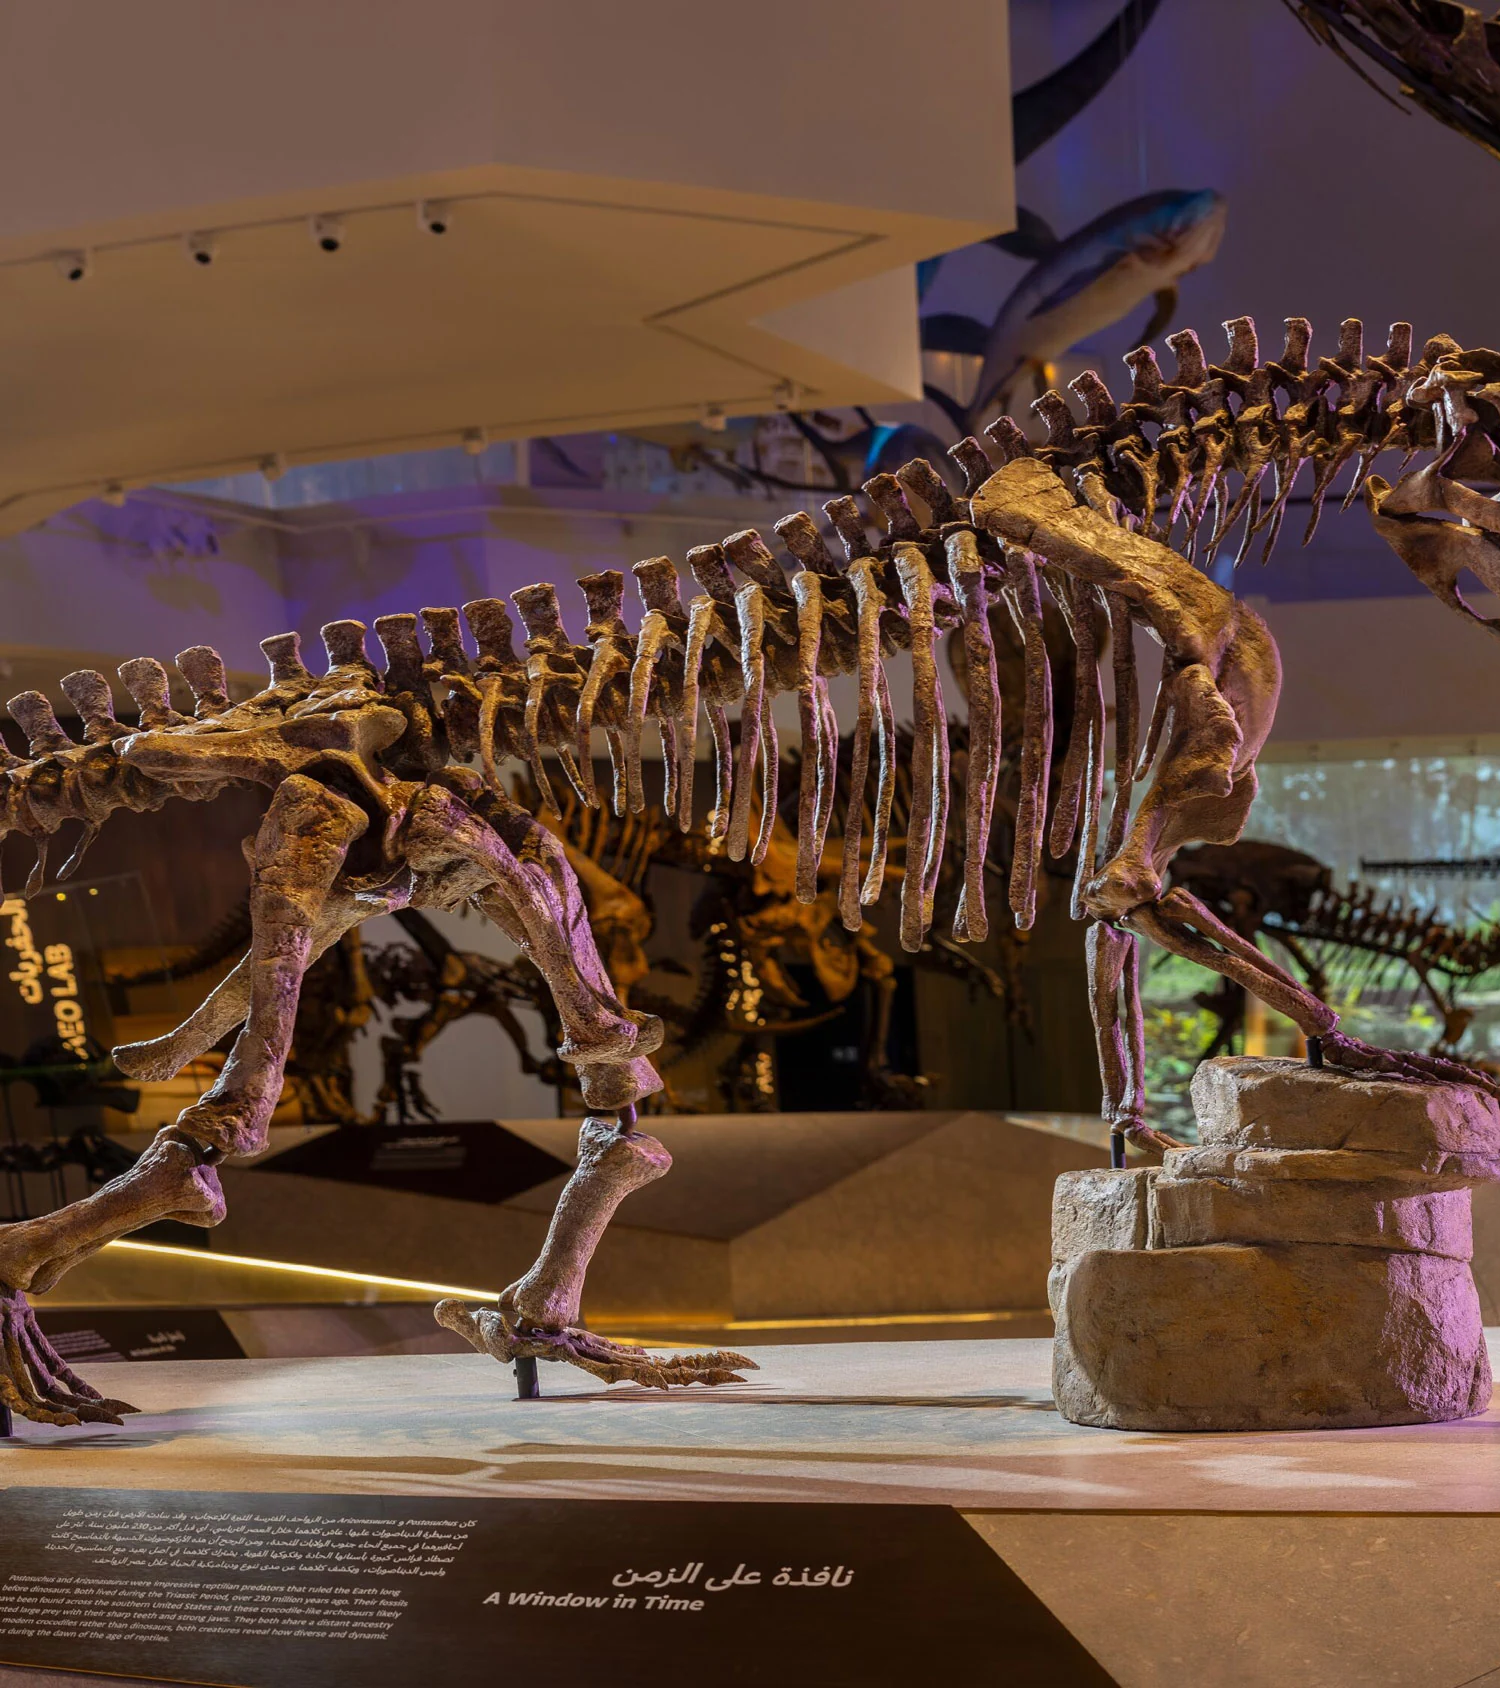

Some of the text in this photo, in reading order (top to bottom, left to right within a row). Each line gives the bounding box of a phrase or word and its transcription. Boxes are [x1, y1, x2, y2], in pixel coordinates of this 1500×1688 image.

[44, 943, 78, 996] LAB
[612, 1562, 854, 1592] نافذة على الزمن
[30, 1586, 71, 1594] dinosaurs.
[96, 1588, 117, 1596] lived
[118, 1590, 146, 1598] during
[200, 1593, 229, 1601] Period,
[154, 1581, 200, 1589] impressive
[240, 1584, 285, 1592] predators
[308, 1586, 333, 1594] ruled
[380, 1589, 401, 1597] long
[110, 1600, 150, 1608] southern
[260, 1606, 322, 1615] crocodile-like
[376, 1611, 402, 1619] likely
[482, 1592, 704, 1611] A Window in Time
[20, 1607, 40, 1615] large
[41, 1608, 61, 1616] prey
[106, 1611, 131, 1619] sharp
[234, 1616, 256, 1624] They
[317, 1619, 350, 1627] distant
[352, 1621, 394, 1630] ancestry
[8, 1628, 35, 1637] during
[129, 1622, 173, 1632] dinosaurs,
[242, 1627, 270, 1635] reveal
[348, 1632, 388, 1640] dynamic
